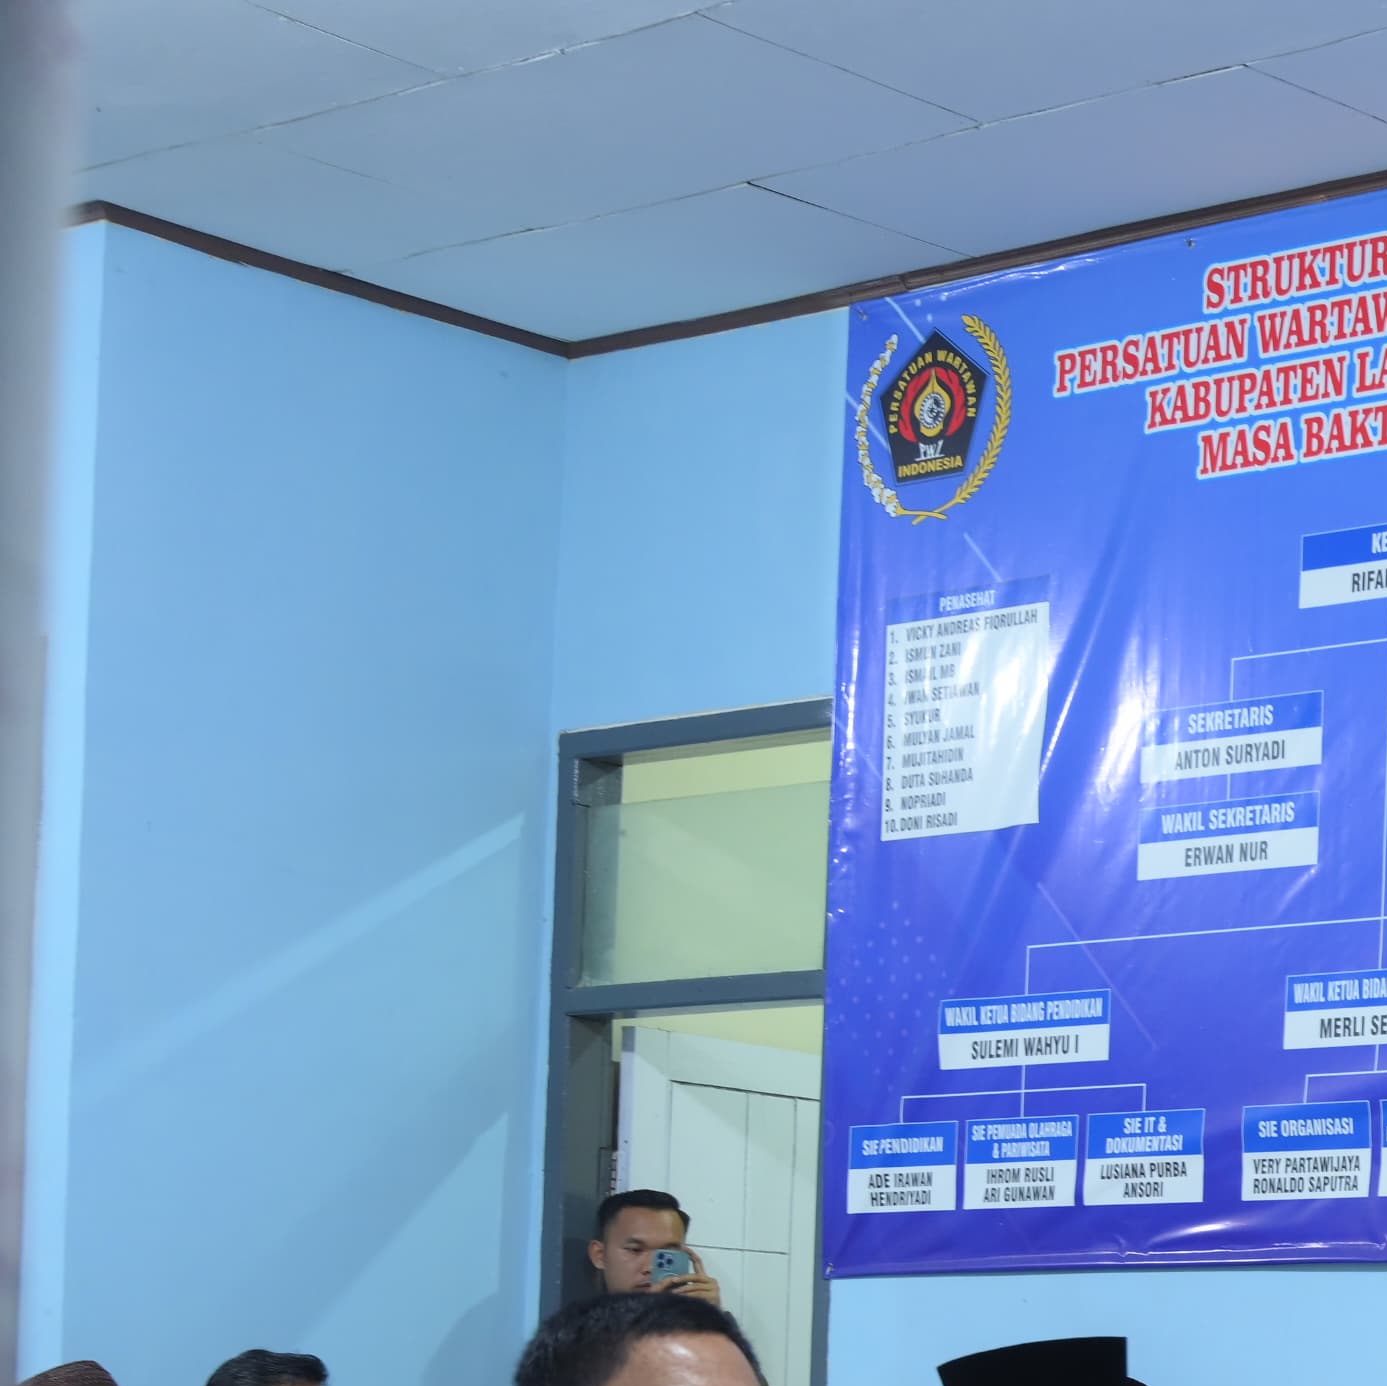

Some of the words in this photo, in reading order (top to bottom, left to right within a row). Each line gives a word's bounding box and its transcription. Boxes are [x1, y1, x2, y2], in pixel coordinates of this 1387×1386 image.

[1055, 318, 1248, 393] PERSATUAN
[888, 351, 934, 435] PERSATUAN
[936, 349, 978, 418] WARTAWAN
[1147, 355, 1346, 429] KABUPATEN
[1200, 421, 1294, 475] MASA
[898, 455, 964, 478] INDONESIA
[939, 590, 996, 612] PENASEHAT
[890, 630, 899, 644] 1.
[906, 625, 936, 642] VICKY
[936, 618, 981, 638] ANDREAS
[888, 650, 898, 665] 2.
[939, 642, 961, 658] ZANI
[905, 667, 936, 684] ISMIL
[1187, 704, 1274, 734] SEKRETARIS
[943, 725, 975, 742] JAMAL
[1174, 747, 1221, 771] ANTON
[1225, 739, 1286, 766] SURYADI
[901, 774, 926, 790] DUTA
[928, 768, 974, 787] SUHANDA
[900, 792, 946, 810] NOPRIADI
[885, 820, 899, 833] 10.
[900, 815, 923, 832] DONI
[1161, 811, 1205, 834] WAKIL
[1208, 801, 1296, 830] SEKRETARIS
[1184, 844, 1234, 867] ERWAN
[1239, 840, 1269, 862] NUR
[1293, 982, 1325, 1004] WAKIL
[1327, 979, 1360, 1002] KETUA
[944, 1006, 979, 1027] WAKIL
[979, 1004, 1009, 1025] KETUA
[1010, 1001, 1045, 1023] BIDANG
[1046, 997, 1103, 1021] PENDIDIKAN
[1319, 1015, 1365, 1039] MERLI
[971, 1038, 1019, 1061] SULEMI
[1023, 1034, 1070, 1057] WAHYU
[971, 1125, 986, 1141] SIE
[1123, 1118, 1142, 1134] SIE
[1144, 1117, 1156, 1133] IT
[1157, 1116, 1167, 1132] &
[1258, 1120, 1278, 1138] SIE
[1280, 1117, 1354, 1137] ORGANISASI
[862, 1139, 878, 1156] SIE
[1105, 1134, 1183, 1154] DOKUMENTASI
[1024, 1166, 1055, 1183] RUSLI
[1100, 1162, 1146, 1180] LUSIANA
[1149, 1161, 1187, 1178] PURBA
[1253, 1157, 1282, 1175] VERY
[1284, 1155, 1360, 1174] PARTAWIJAYA
[868, 1173, 890, 1189] ADE
[894, 1172, 933, 1188] IRAWAN
[1123, 1181, 1163, 1198] ANSORI
[1253, 1176, 1304, 1194] RONALDO
[1308, 1175, 1359, 1192] SAPUTRA
[983, 1187, 1000, 1203] ARI
[1004, 1185, 1056, 1202] GUNAWAN
